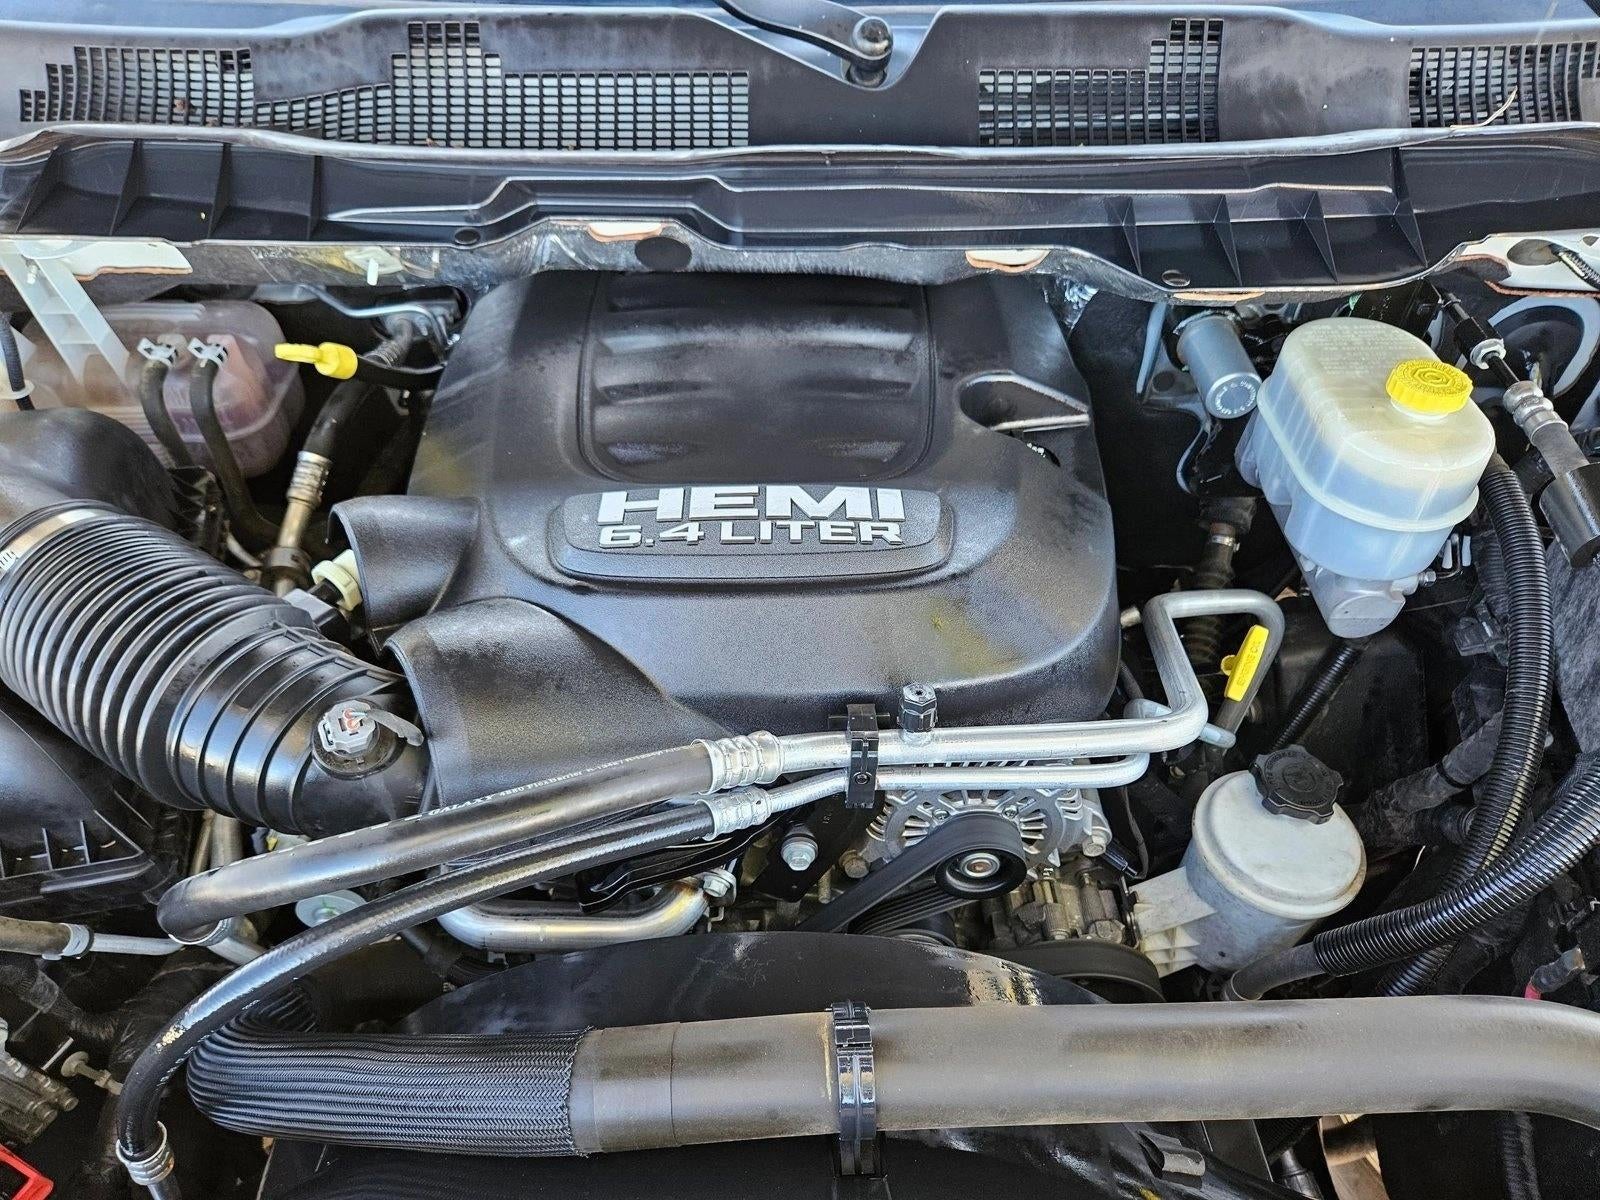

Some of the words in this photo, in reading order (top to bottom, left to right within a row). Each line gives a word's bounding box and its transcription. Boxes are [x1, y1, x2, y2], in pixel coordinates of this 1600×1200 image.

[597, 485, 906, 525] HEMI
[598, 521, 705, 549] 6.4
[719, 520, 903, 546] LITER
